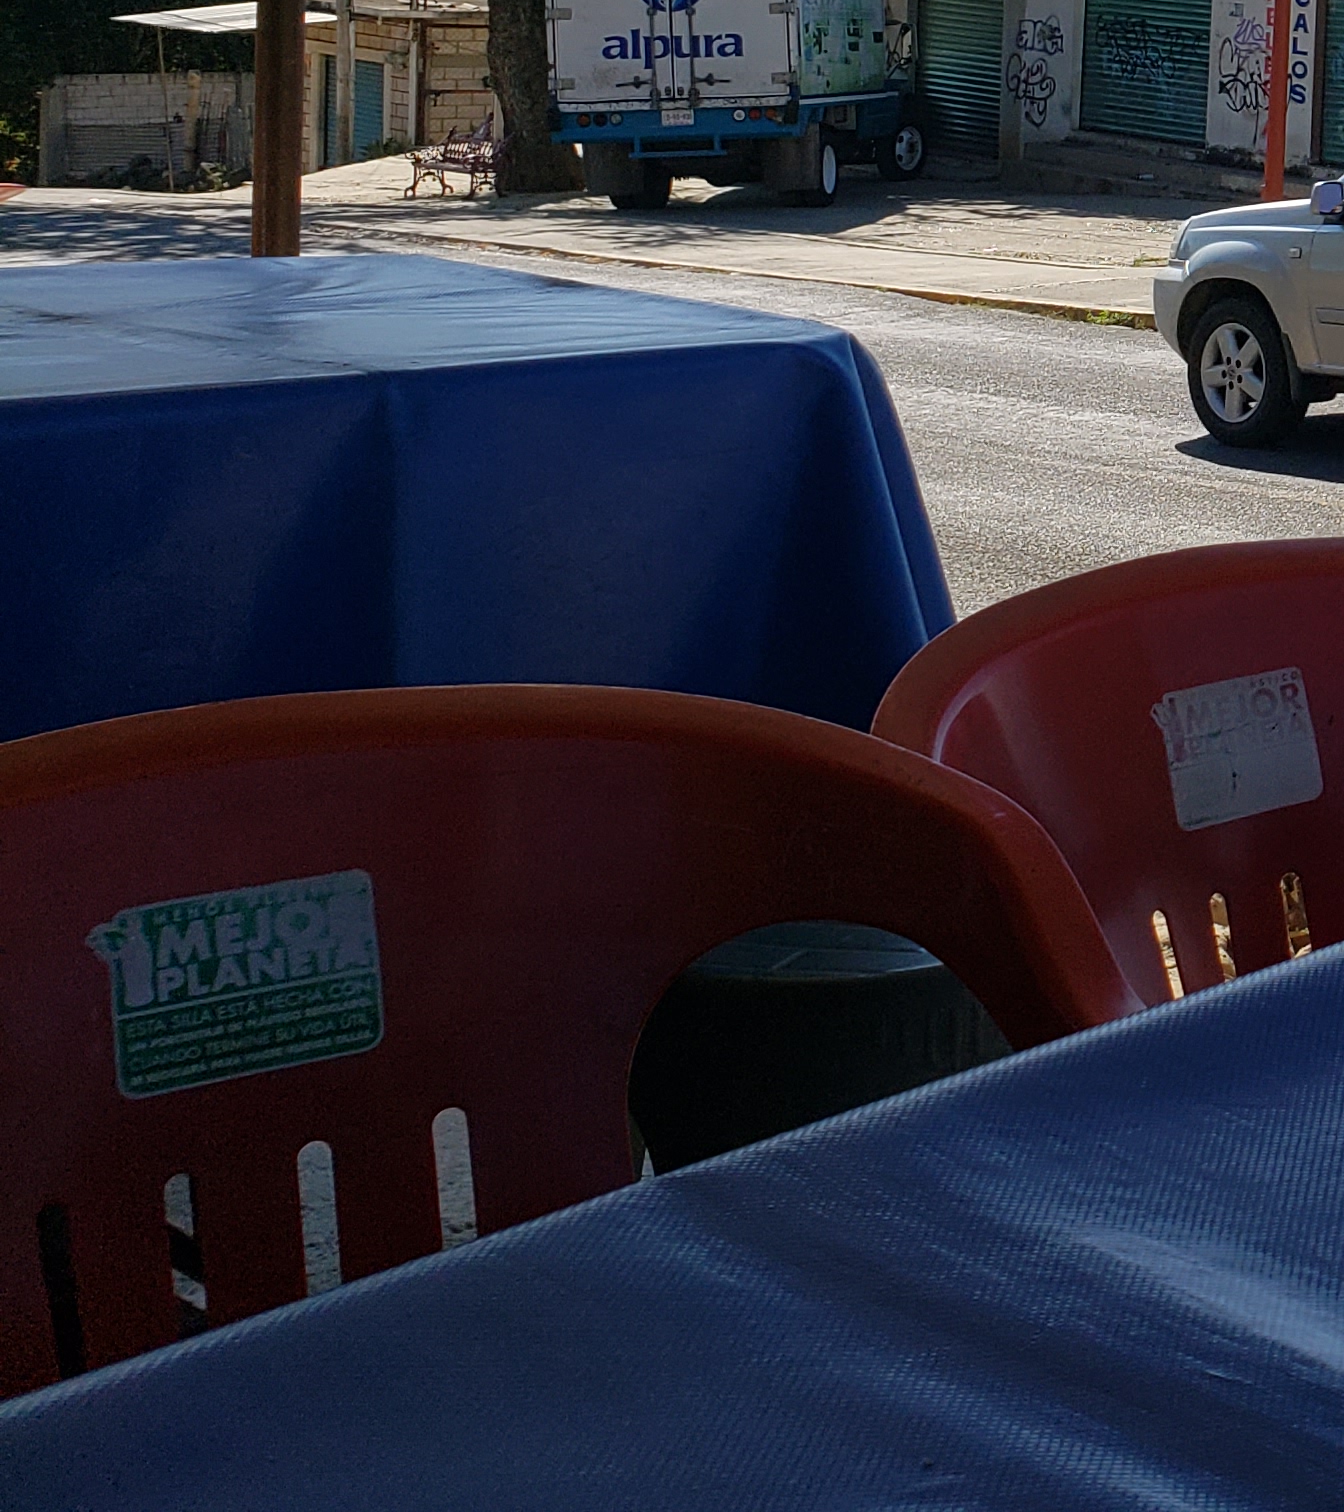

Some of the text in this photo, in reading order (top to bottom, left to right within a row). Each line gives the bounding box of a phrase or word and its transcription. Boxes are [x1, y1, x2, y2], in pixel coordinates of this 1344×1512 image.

[601, 28, 744, 70] alpura
[154, 933, 371, 1003] PLANETA
[125, 1016, 166, 1038] ESTA
